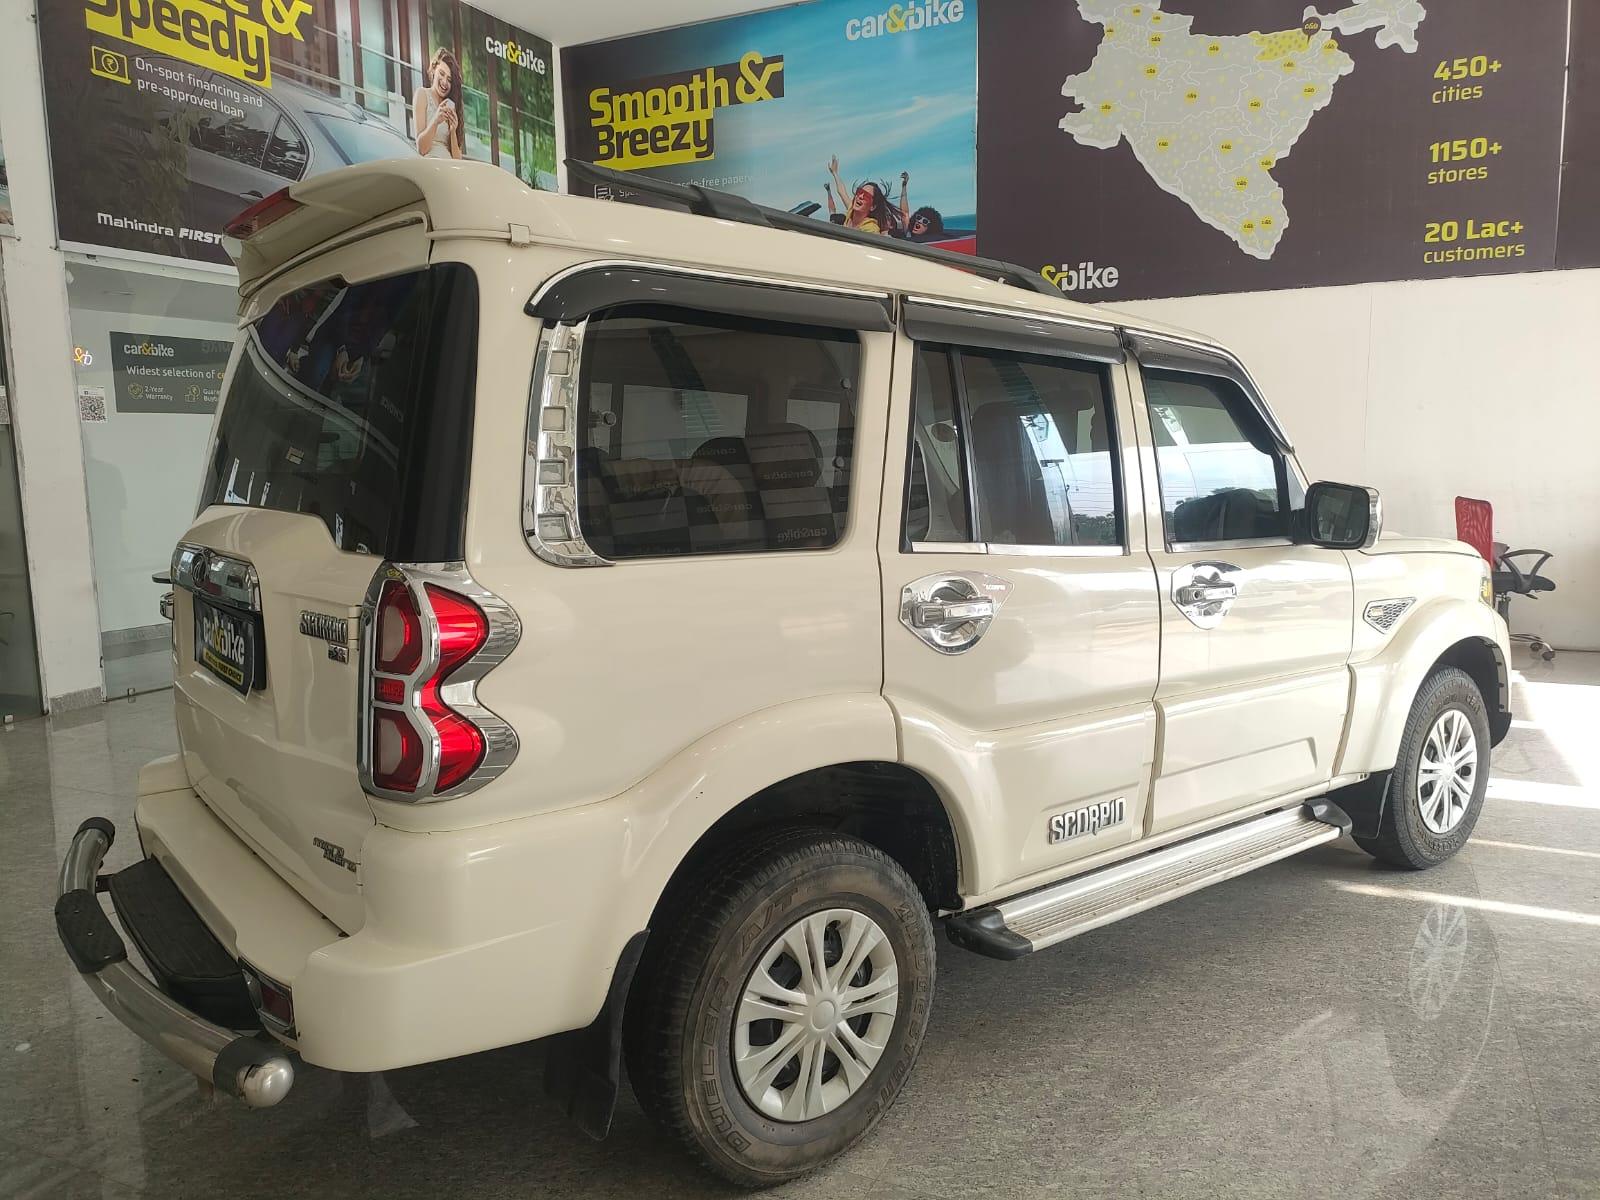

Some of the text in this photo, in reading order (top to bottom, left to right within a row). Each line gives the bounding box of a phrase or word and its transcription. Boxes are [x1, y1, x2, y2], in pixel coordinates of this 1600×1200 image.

[846, 0, 965, 41] car&bike
[485, 36, 546, 75] car&bike
[1433, 55, 1502, 81] 450+
[135, 57, 263, 108] On-spot financing and
[137, 78, 244, 118] pre-approved loan
[589, 51, 784, 127] Smooth &
[1432, 84, 1483, 104] cities
[592, 118, 715, 161] Breezy
[1429, 137, 1503, 163] 1150+
[1427, 165, 1488, 185] stores
[97, 212, 223, 245] Mahindra FIRST
[1424, 219, 1524, 243] 20 Lac+
[1423, 243, 1526, 264] customers
[123, 343, 175, 357] car&bike
[126, 365, 161, 377] Widest
[161, 367, 204, 379] selection
[205, 369, 216, 379] of
[203, 616, 245, 665] car&bike
[1049, 797, 1127, 845] SCORPIO
